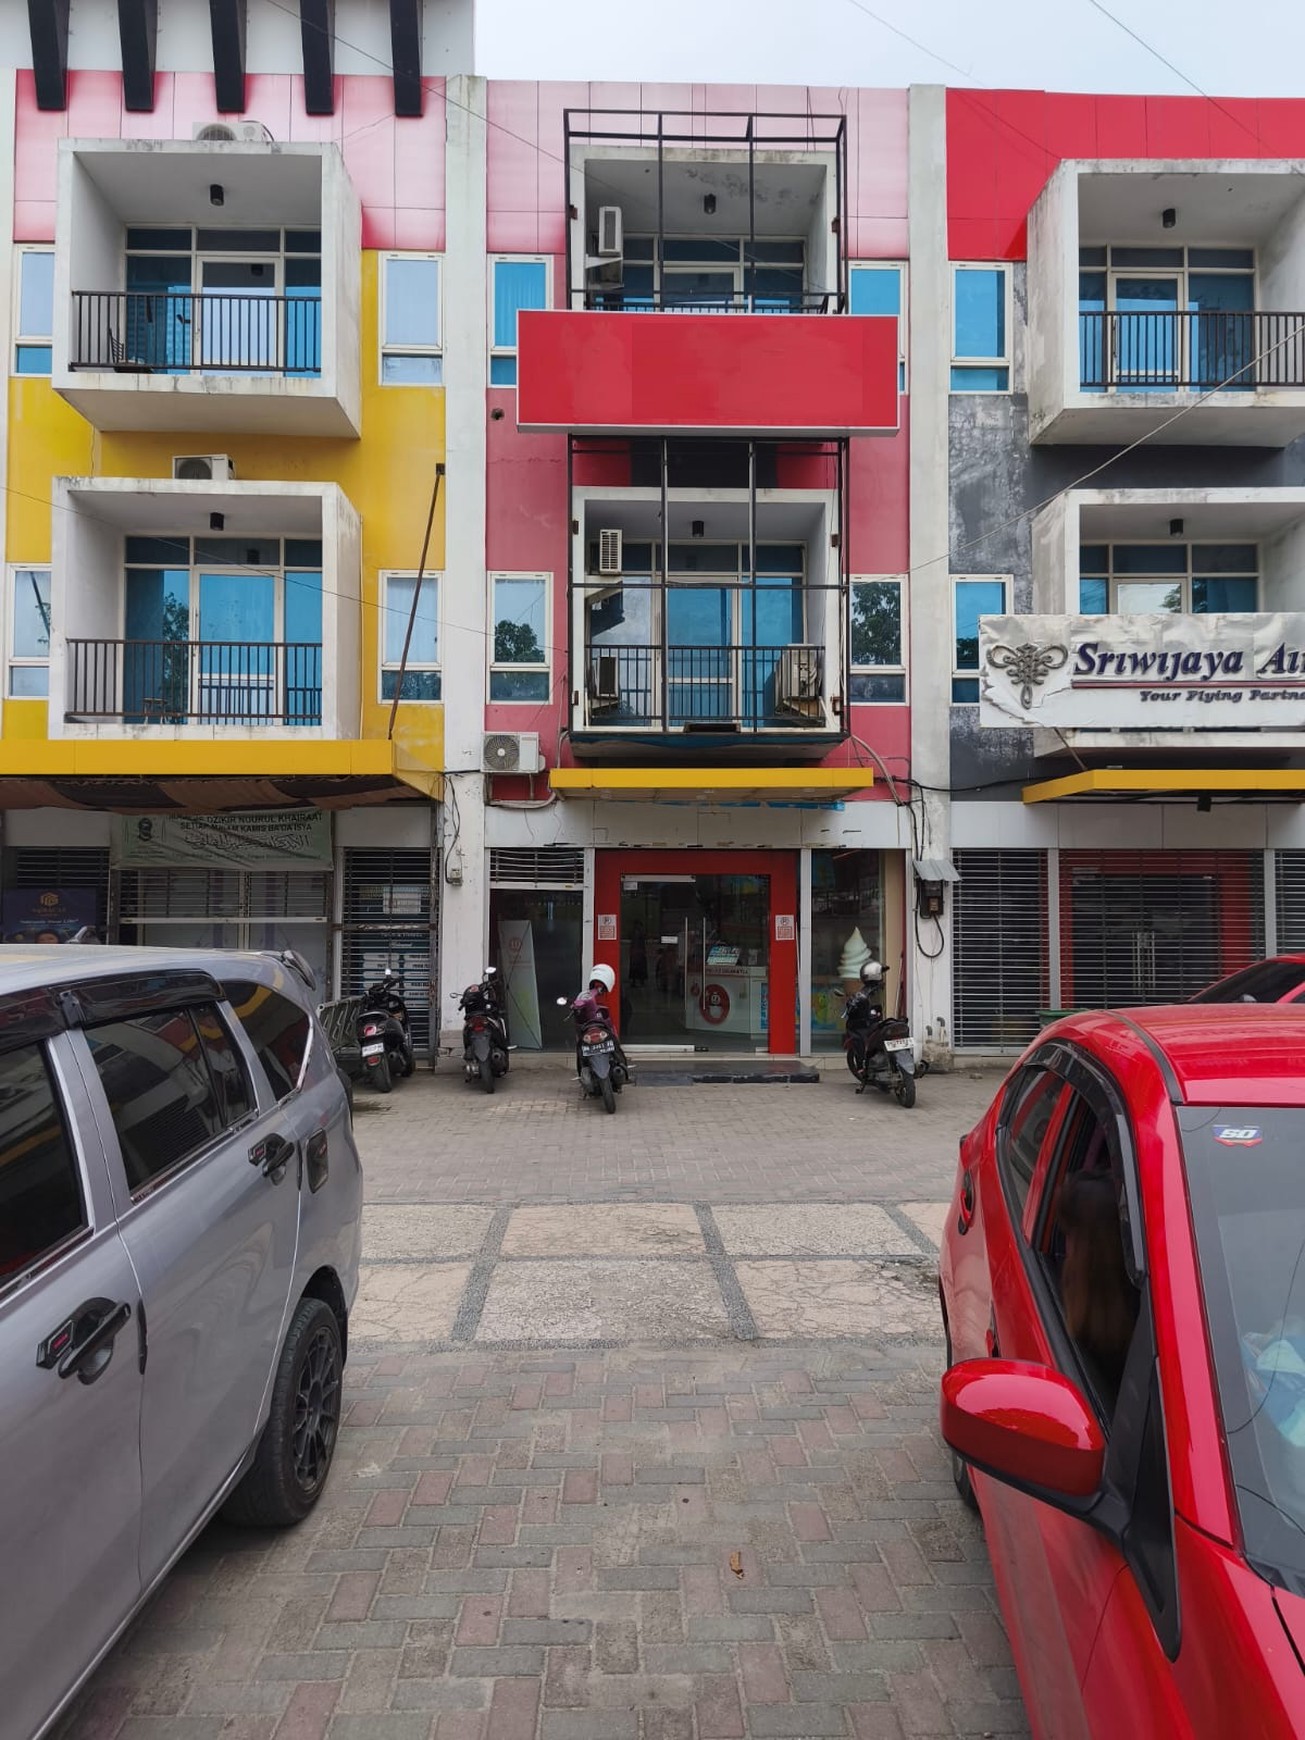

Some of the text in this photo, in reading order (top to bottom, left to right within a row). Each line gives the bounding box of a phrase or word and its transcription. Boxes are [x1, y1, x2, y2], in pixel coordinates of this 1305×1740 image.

[1073, 642, 1244, 681] Sriwijaya
[1140, 690, 1182, 702] Your
[1186, 690, 1242, 703] Flying
